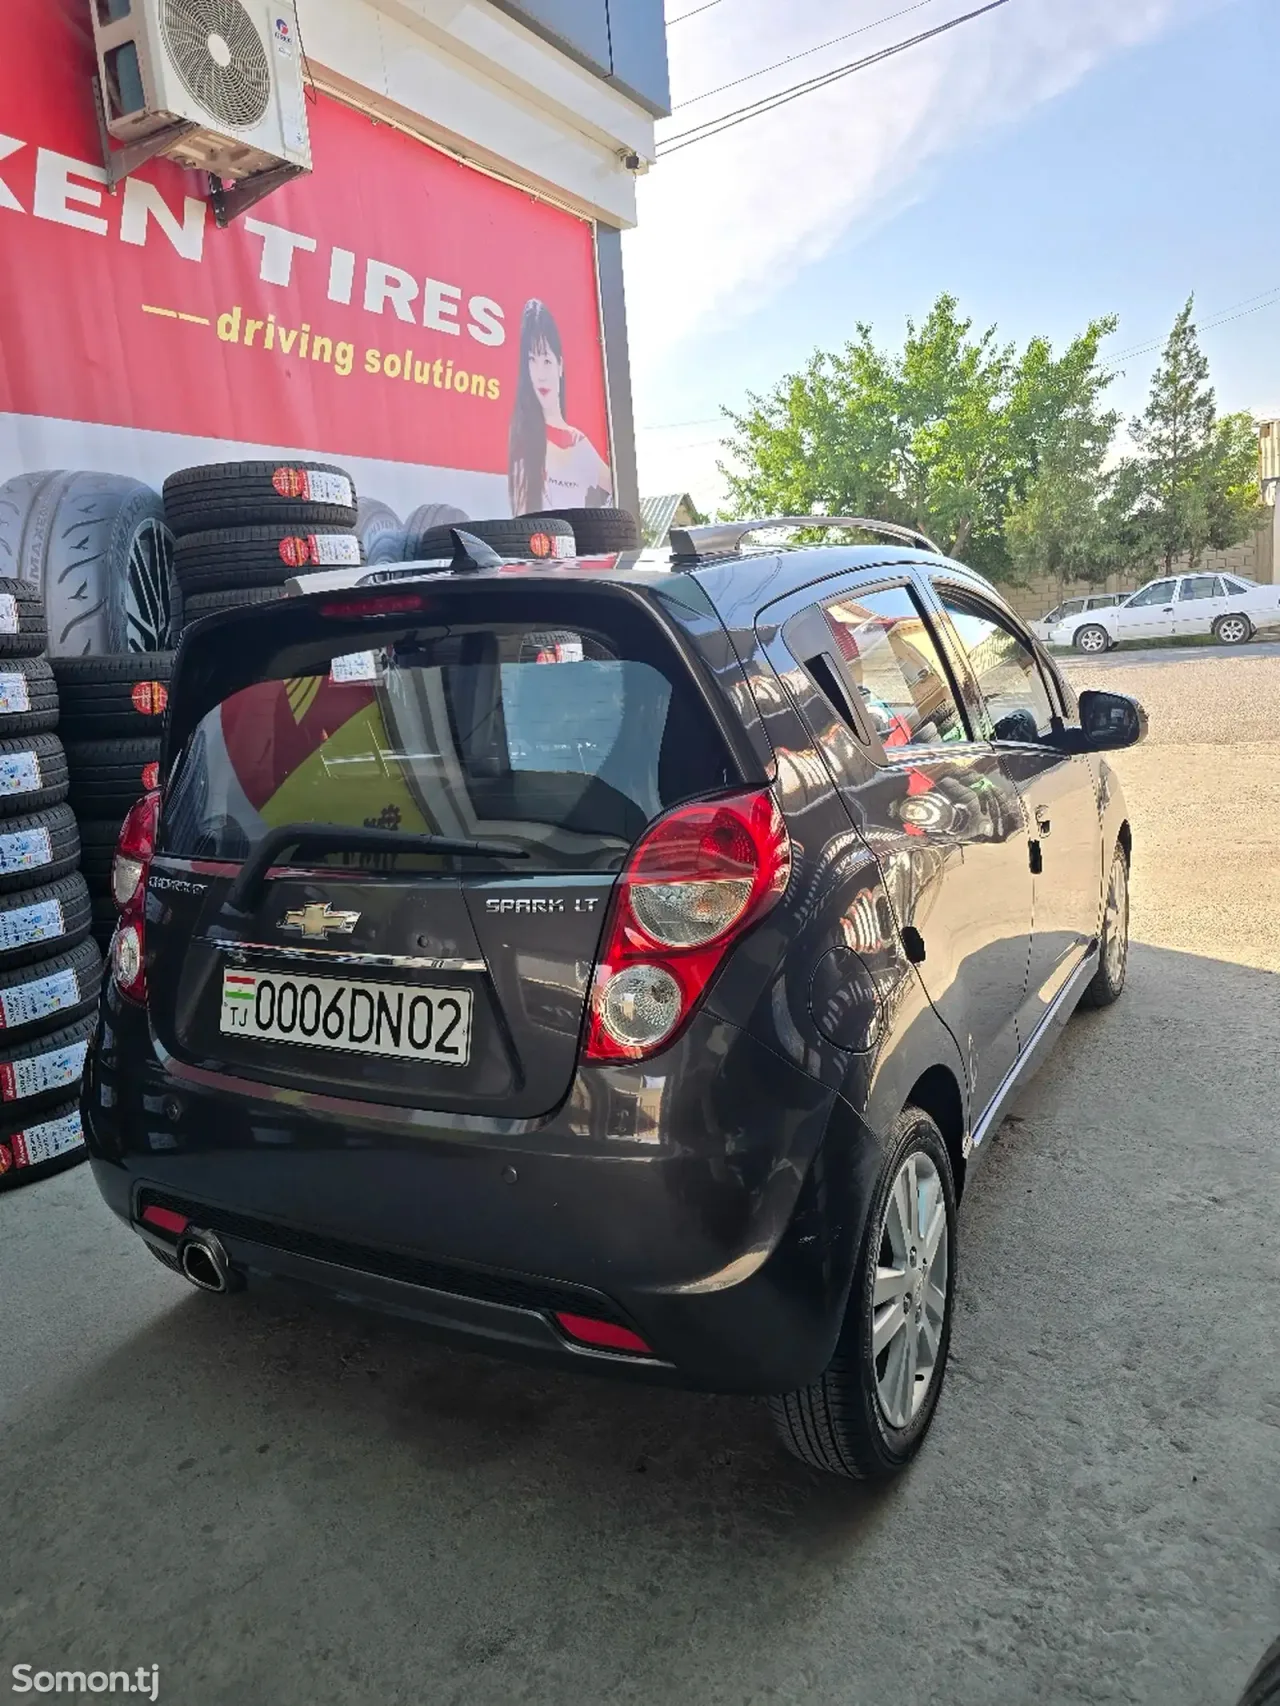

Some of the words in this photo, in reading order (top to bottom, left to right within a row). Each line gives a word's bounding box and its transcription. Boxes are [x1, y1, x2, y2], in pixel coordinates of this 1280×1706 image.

[244, 216, 506, 347] TIRES
[217, 307, 355, 376] driving
[364, 349, 500, 401] solutions
[486, 898, 565, 914] SPARK
[574, 898, 600, 913] LT
[229, 1006, 249, 1028] TJ
[255, 979, 463, 1056] 0006DN02
